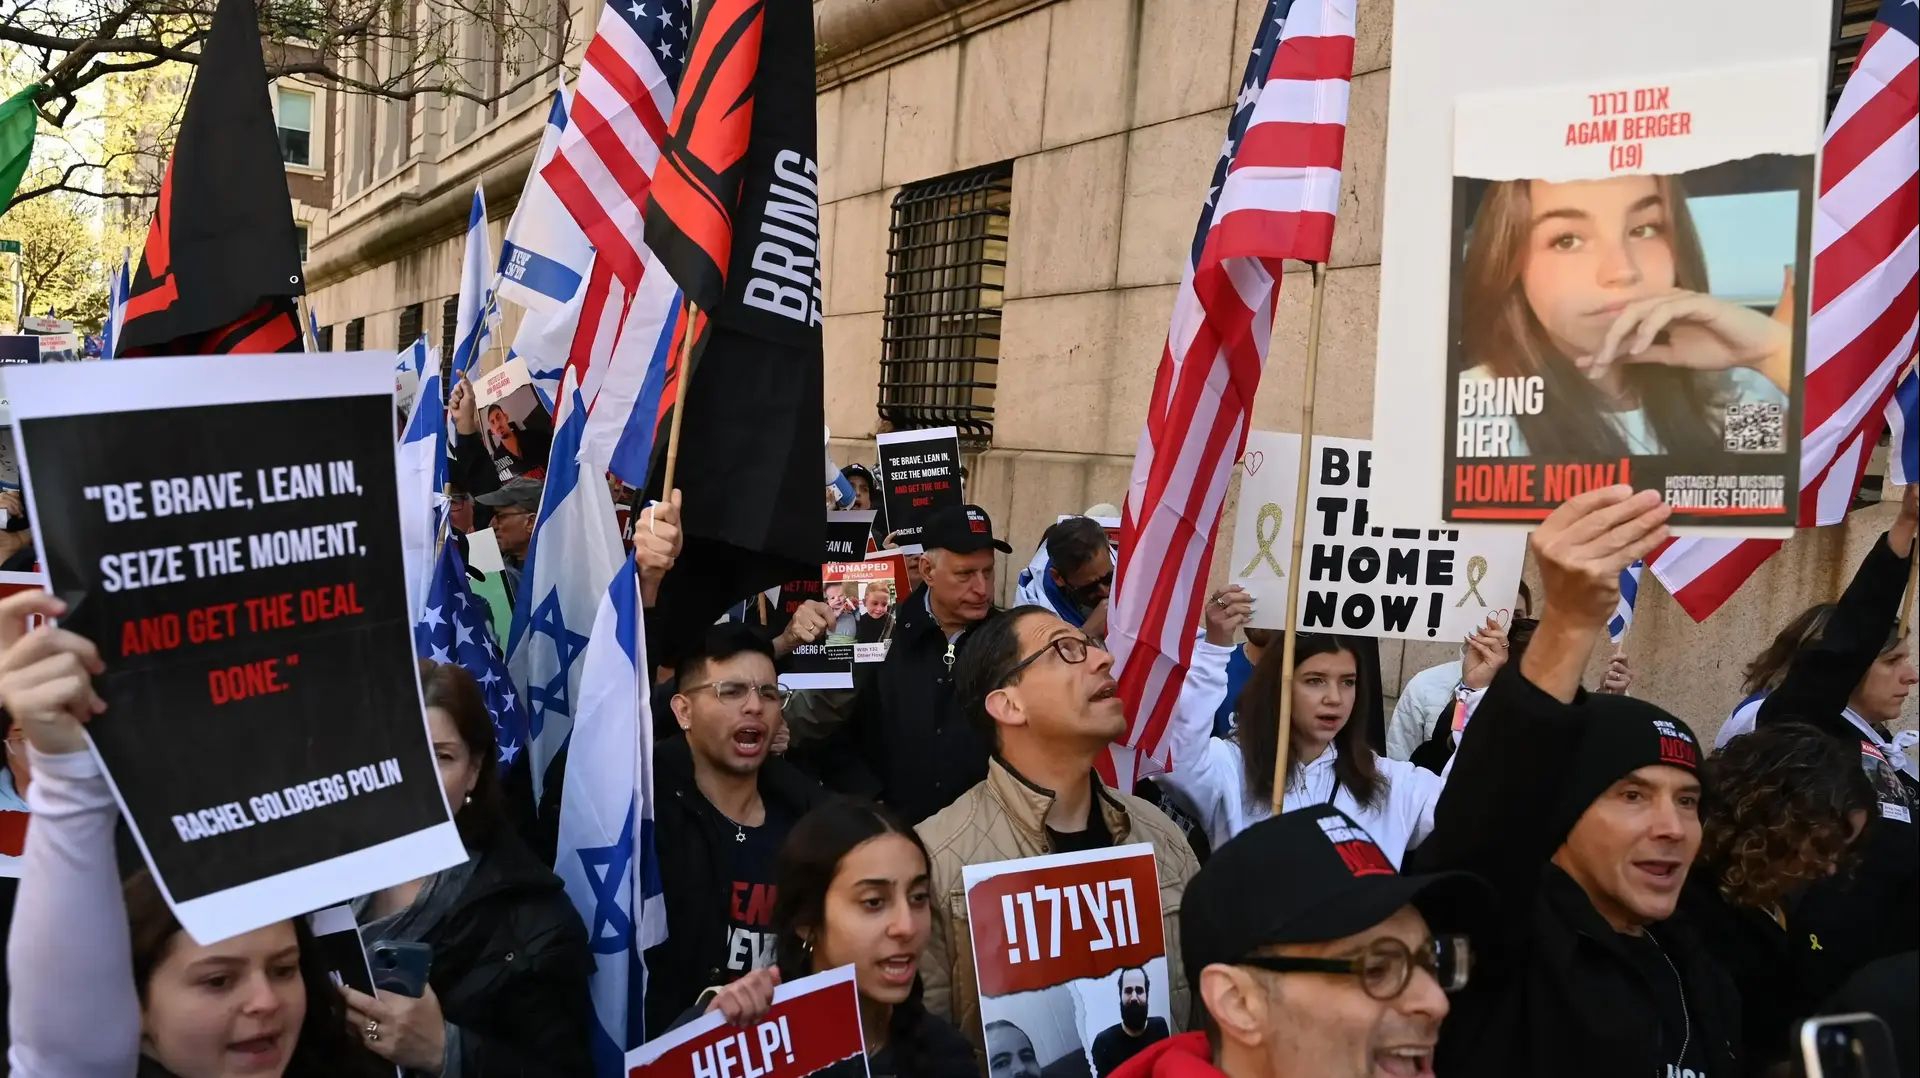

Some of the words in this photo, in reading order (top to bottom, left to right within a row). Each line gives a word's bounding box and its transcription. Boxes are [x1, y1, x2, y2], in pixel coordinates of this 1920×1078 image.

[1565, 120, 1617, 147] AGAM
[1622, 112, 1692, 140] BERGER
[1609, 143, 1643, 172] (19)
[743, 149, 819, 323] BRING
[1458, 376, 1545, 418] BRING
[901, 454, 924, 465] BRAVE,
[924, 453, 940, 463] LEAN
[1456, 418, 1512, 458] HER
[83, 481, 148, 523] "BE
[150, 471, 254, 511] BRAVE,
[256, 462, 325, 504] LEAN
[328, 459, 363, 497] IN,
[890, 471, 908, 481] SEIZE
[908, 469, 921, 479] THE
[1455, 464, 1536, 503] HOME
[1665, 475, 1716, 489] HOSTAGES
[1716, 475, 1738, 489] AND
[1739, 475, 1785, 489] MISSING
[1317, 497, 1459, 541] TH
[1665, 489, 1729, 508] FAMILIES
[1731, 488, 1785, 508] FORUM
[99, 545, 187, 593] SEIZE
[188, 537, 244, 578] THE
[248, 520, 367, 570] MOMENT,
[827, 562, 888, 574] KIDNAPPED
[842, 541, 854, 555] IN,
[1309, 544, 1455, 586] HOME
[121, 613, 182, 657] AND
[187, 602, 238, 644] GET
[244, 593, 296, 632] THE
[300, 582, 365, 623] DEAL
[1303, 591, 1443, 637] NOW!
[208, 653, 299, 706] DONE."
[171, 801, 256, 843] RACHEL
[249, 773, 349, 823] GOLDBERG
[346, 757, 403, 796] POLIN
[1001, 877, 1141, 965] הצילו!
[691, 1015, 795, 1078] HELP!
